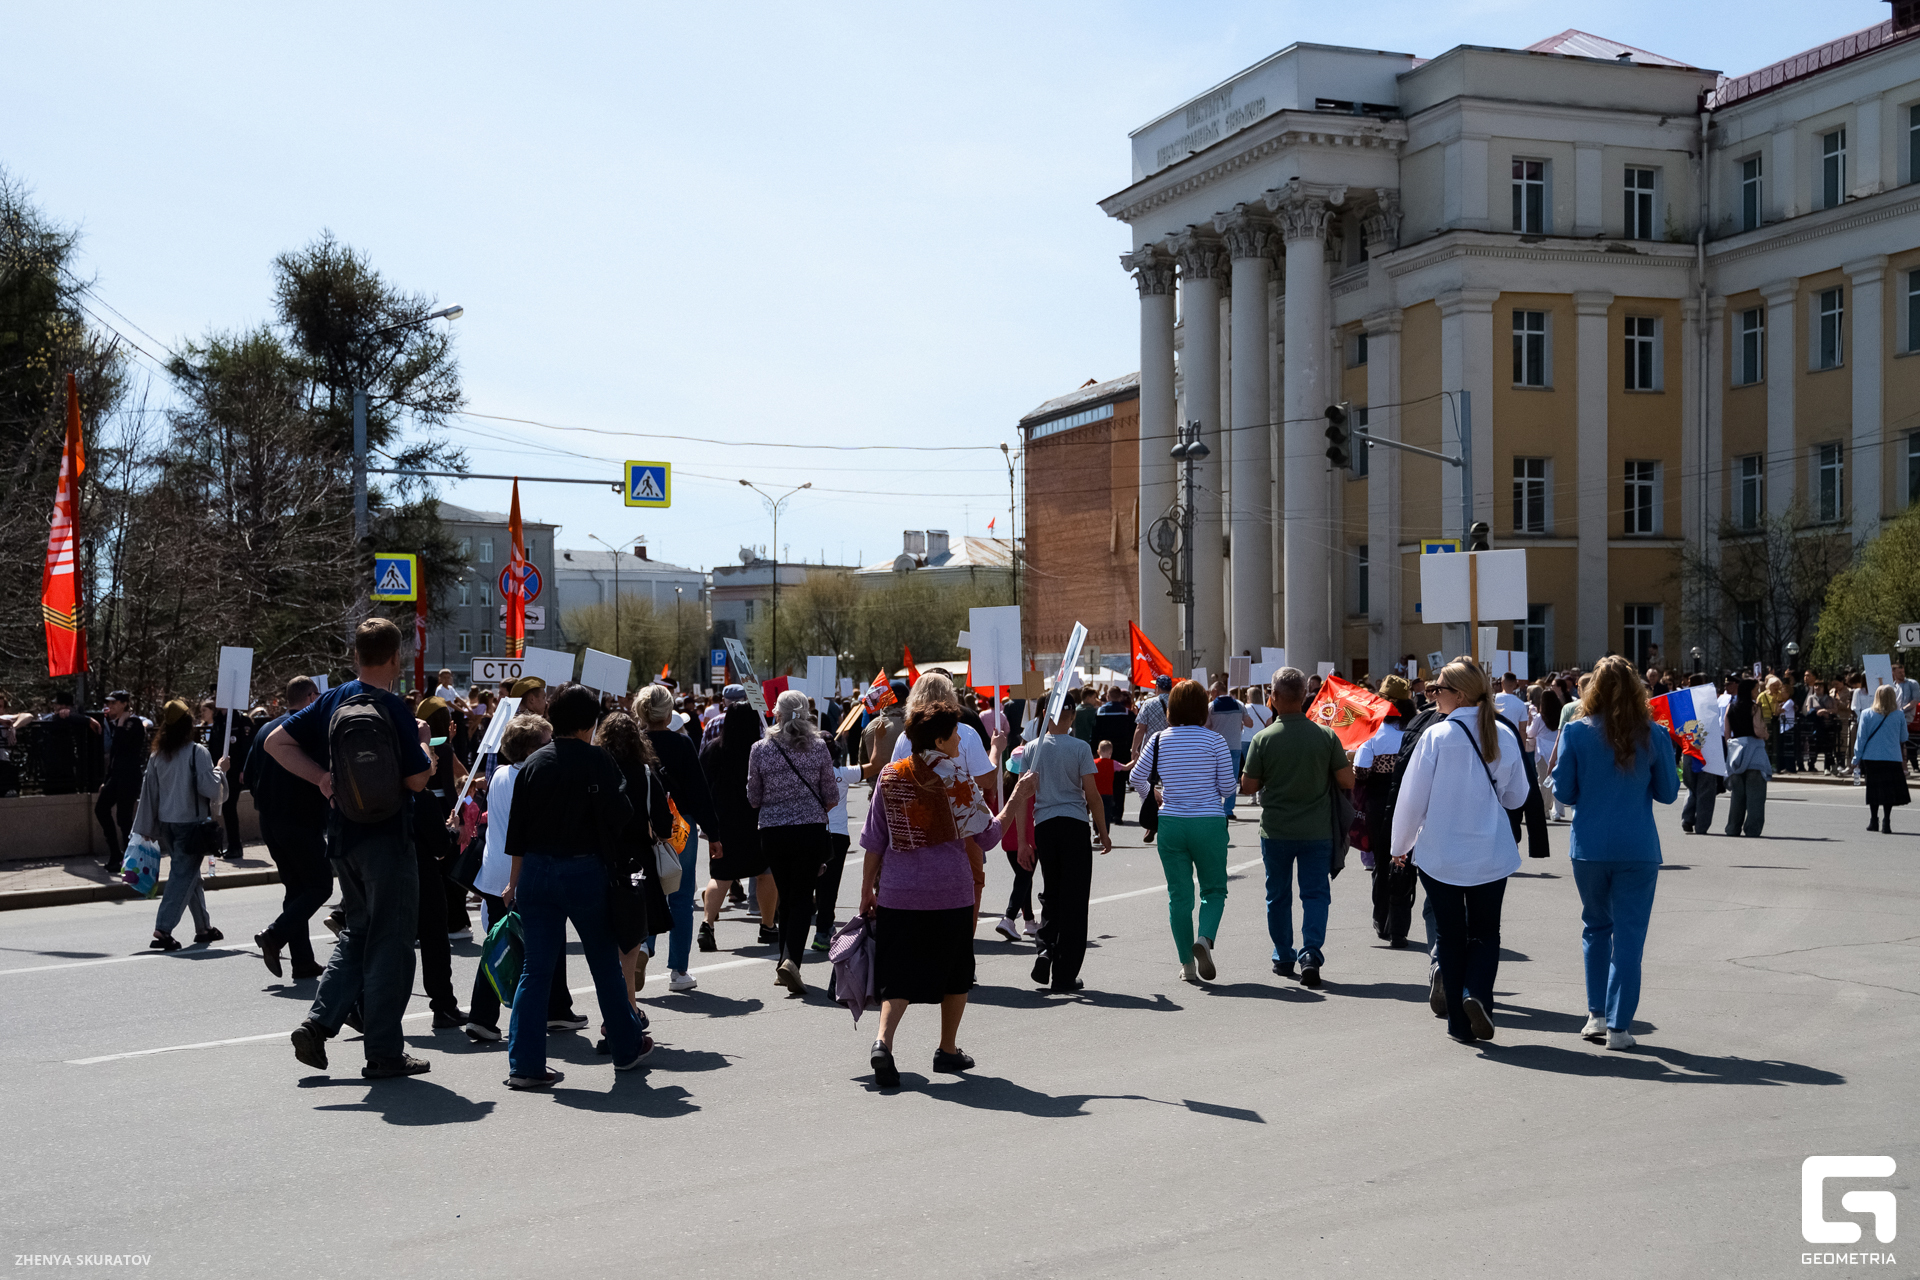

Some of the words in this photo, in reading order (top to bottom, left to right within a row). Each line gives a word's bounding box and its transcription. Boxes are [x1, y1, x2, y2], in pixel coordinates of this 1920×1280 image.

[1157, 119, 1219, 167] ИНОСТРАННЫХ
[1225, 97, 1266, 133] ЯЗЫКОВ
[1186, 88, 1233, 129] ИНСТИТУТ
